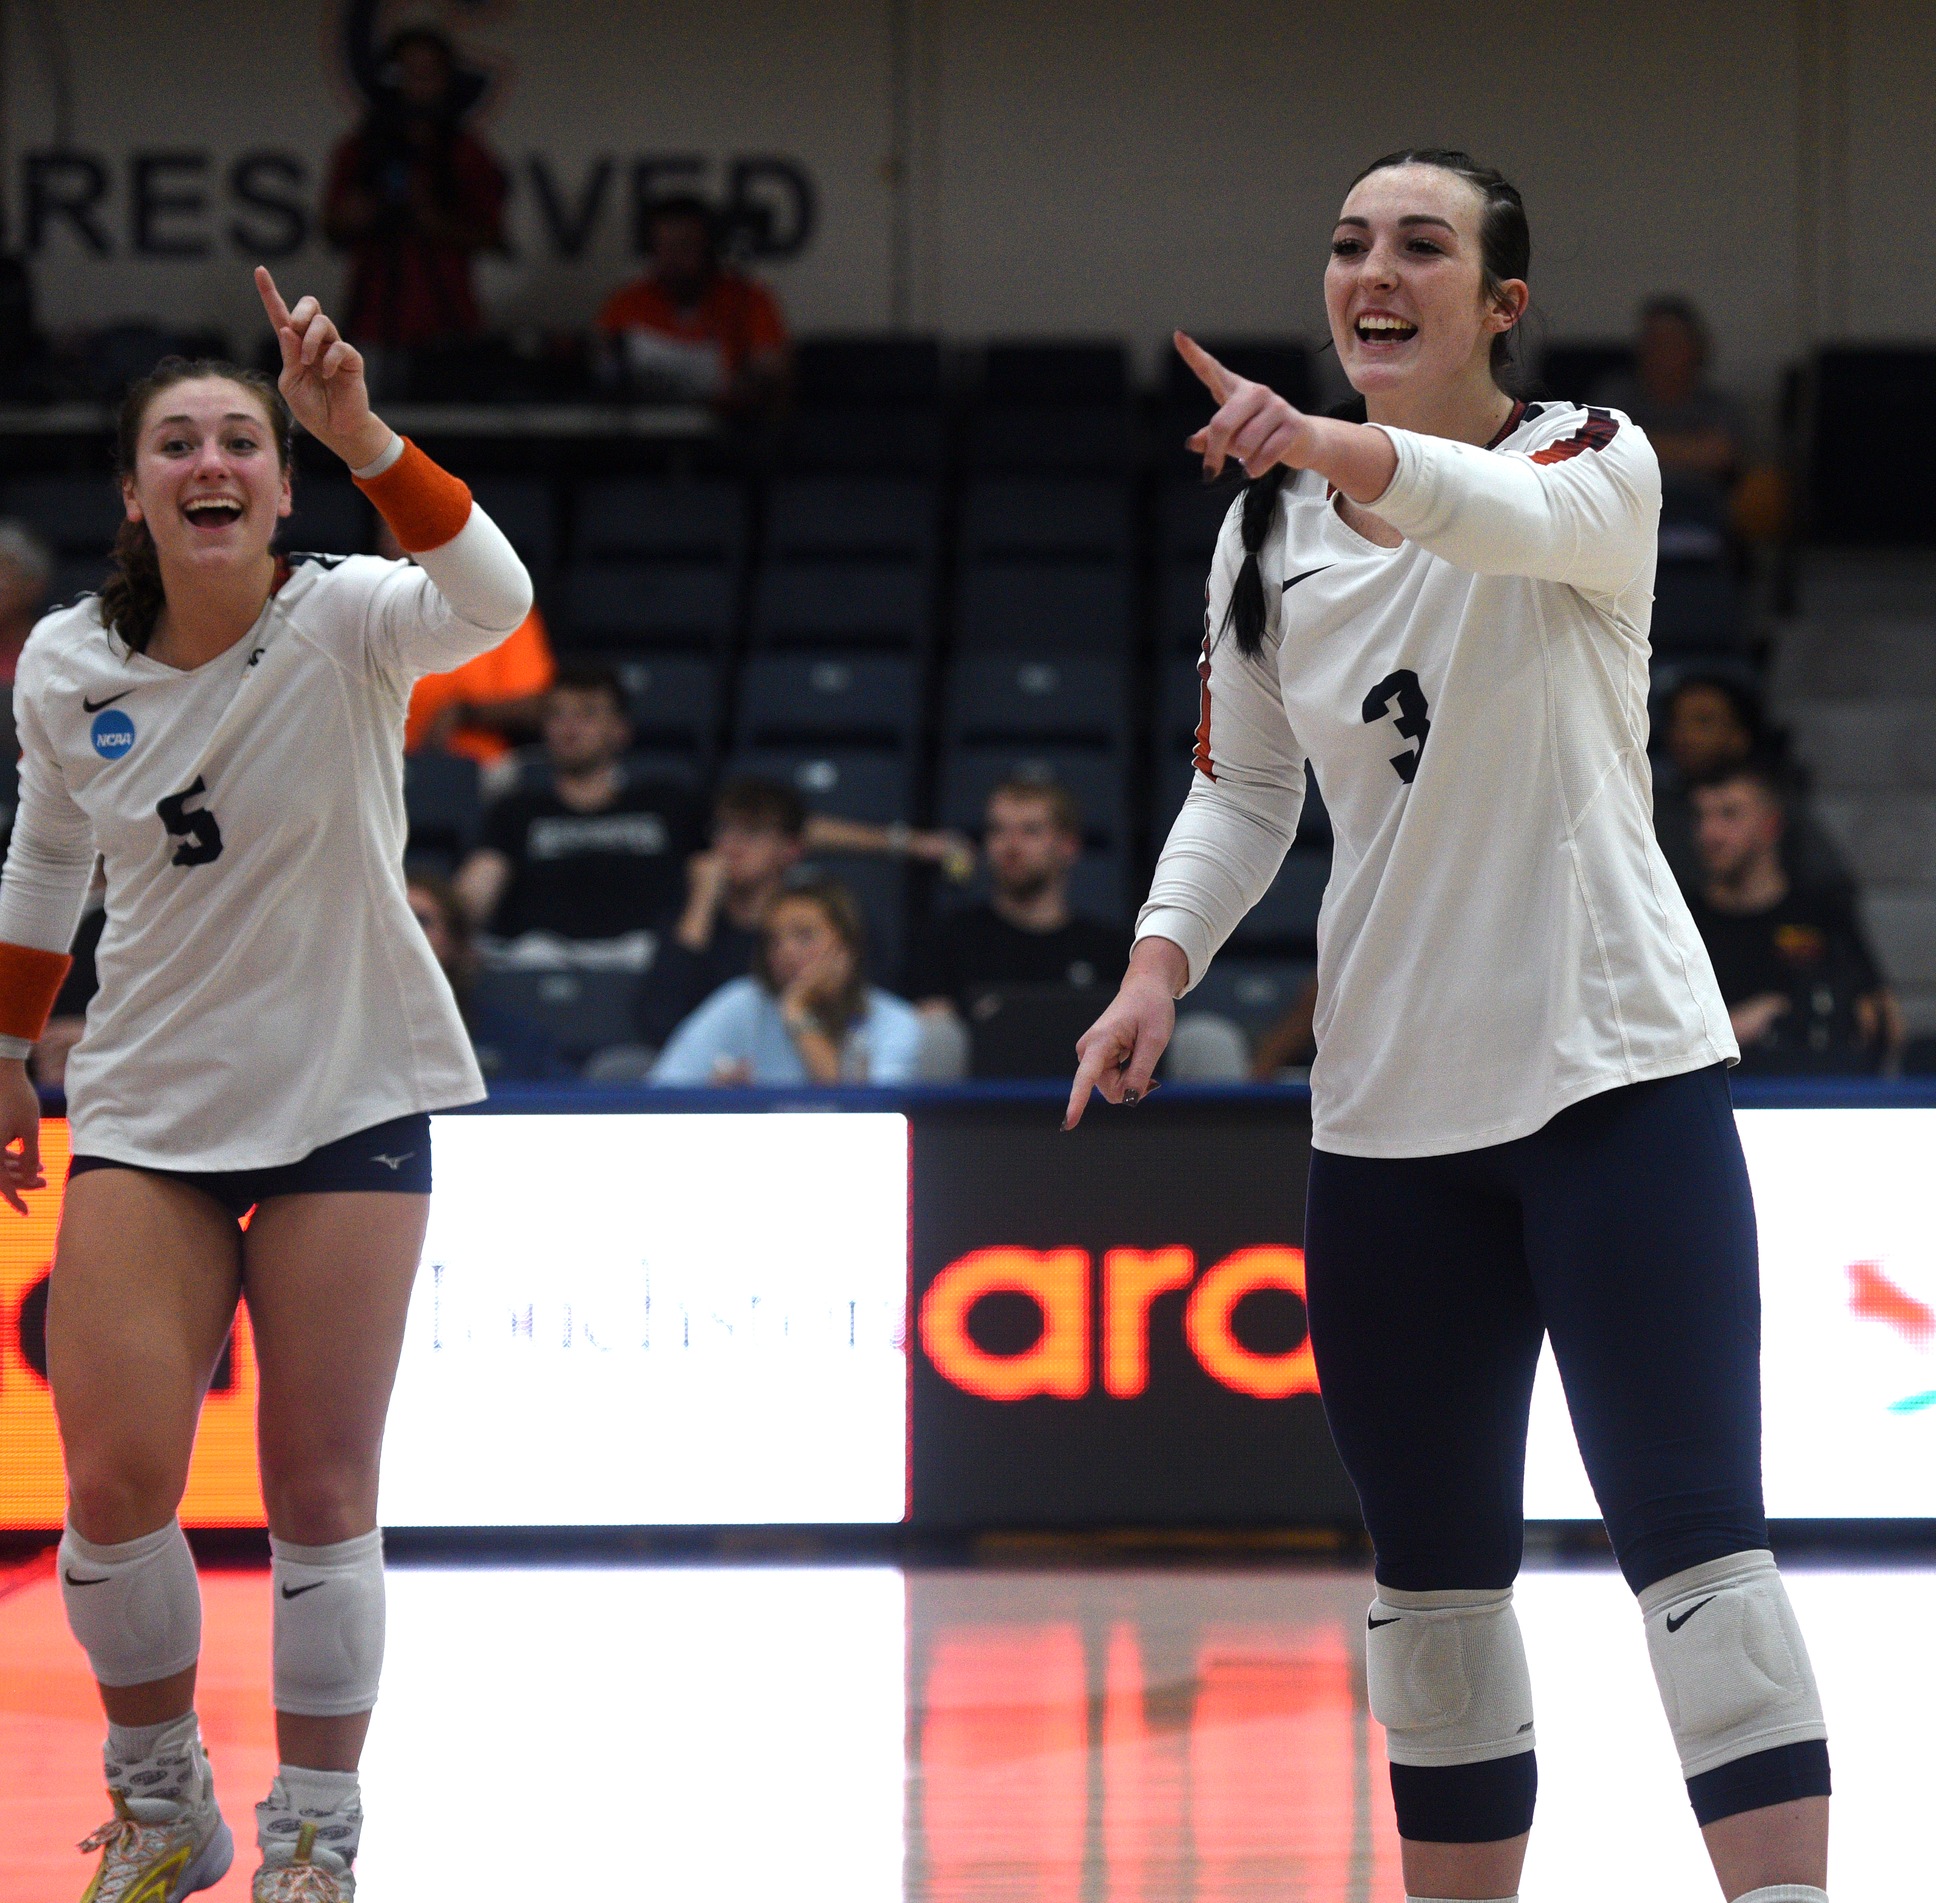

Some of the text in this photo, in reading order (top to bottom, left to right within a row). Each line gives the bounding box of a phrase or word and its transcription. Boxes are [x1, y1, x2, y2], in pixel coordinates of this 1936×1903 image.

[20, 149, 822, 258] RESVED
[97, 733, 131, 748] NCAA
[1362, 668, 1431, 785] 3
[156, 774, 224, 867] 5
